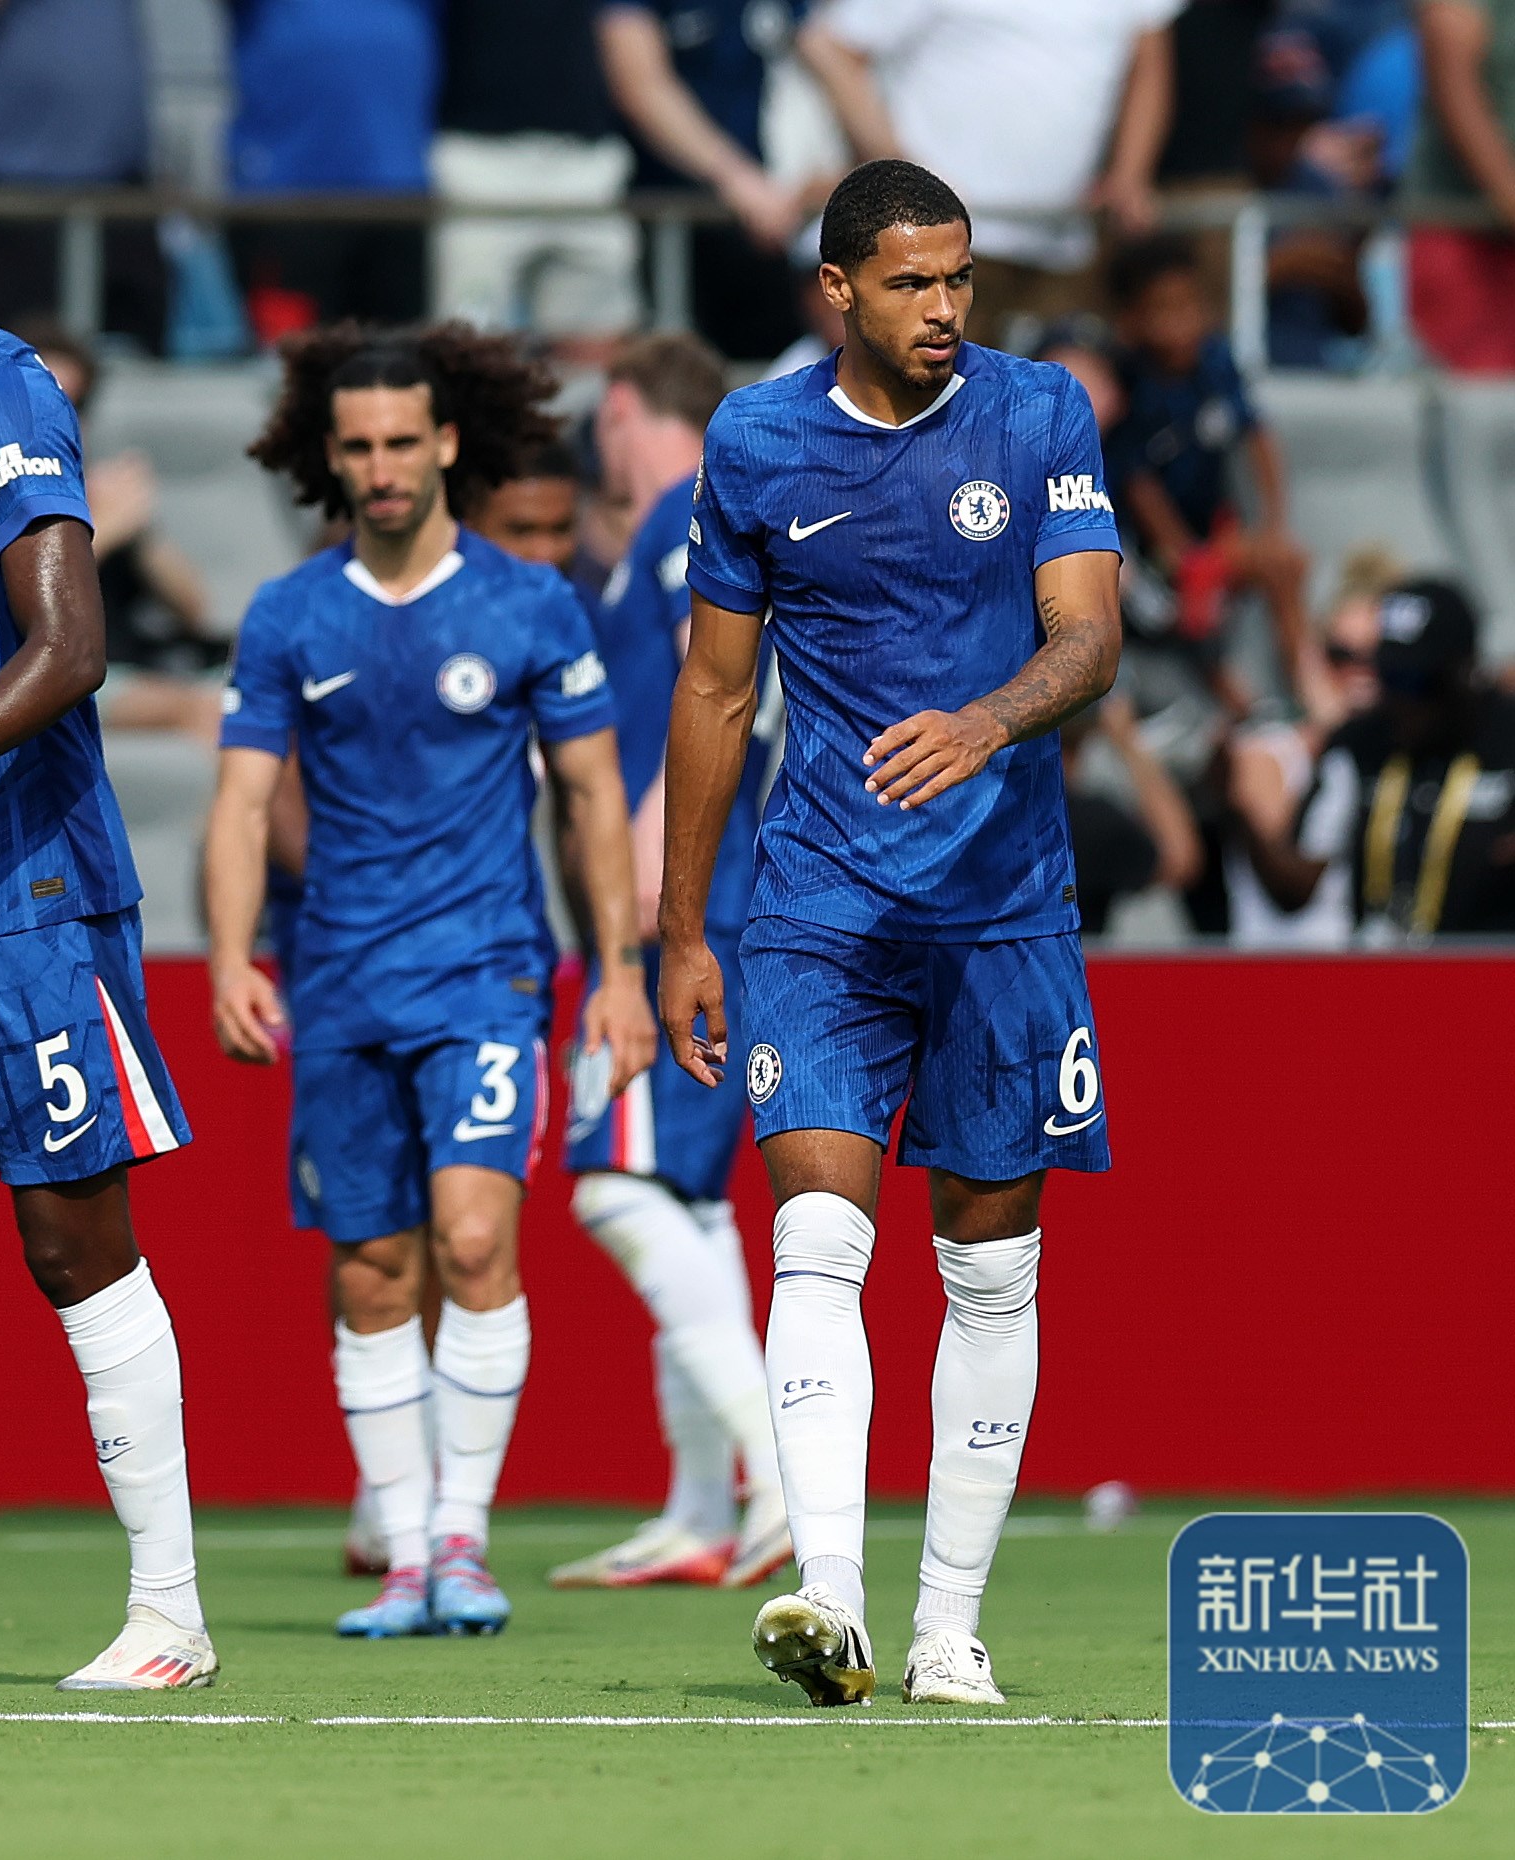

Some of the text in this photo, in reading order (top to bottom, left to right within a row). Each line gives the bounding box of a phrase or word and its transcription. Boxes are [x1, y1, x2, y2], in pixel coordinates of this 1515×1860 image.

[958, 483, 997, 497] CHELSEA
[1047, 474, 1093, 494] LIVE
[35, 1030, 87, 1122] 5
[1059, 1026, 1098, 1114] 6
[471, 1041, 520, 1122] 3
[784, 1378, 834, 1393] CFC
[972, 1420, 1021, 1434] CFC
